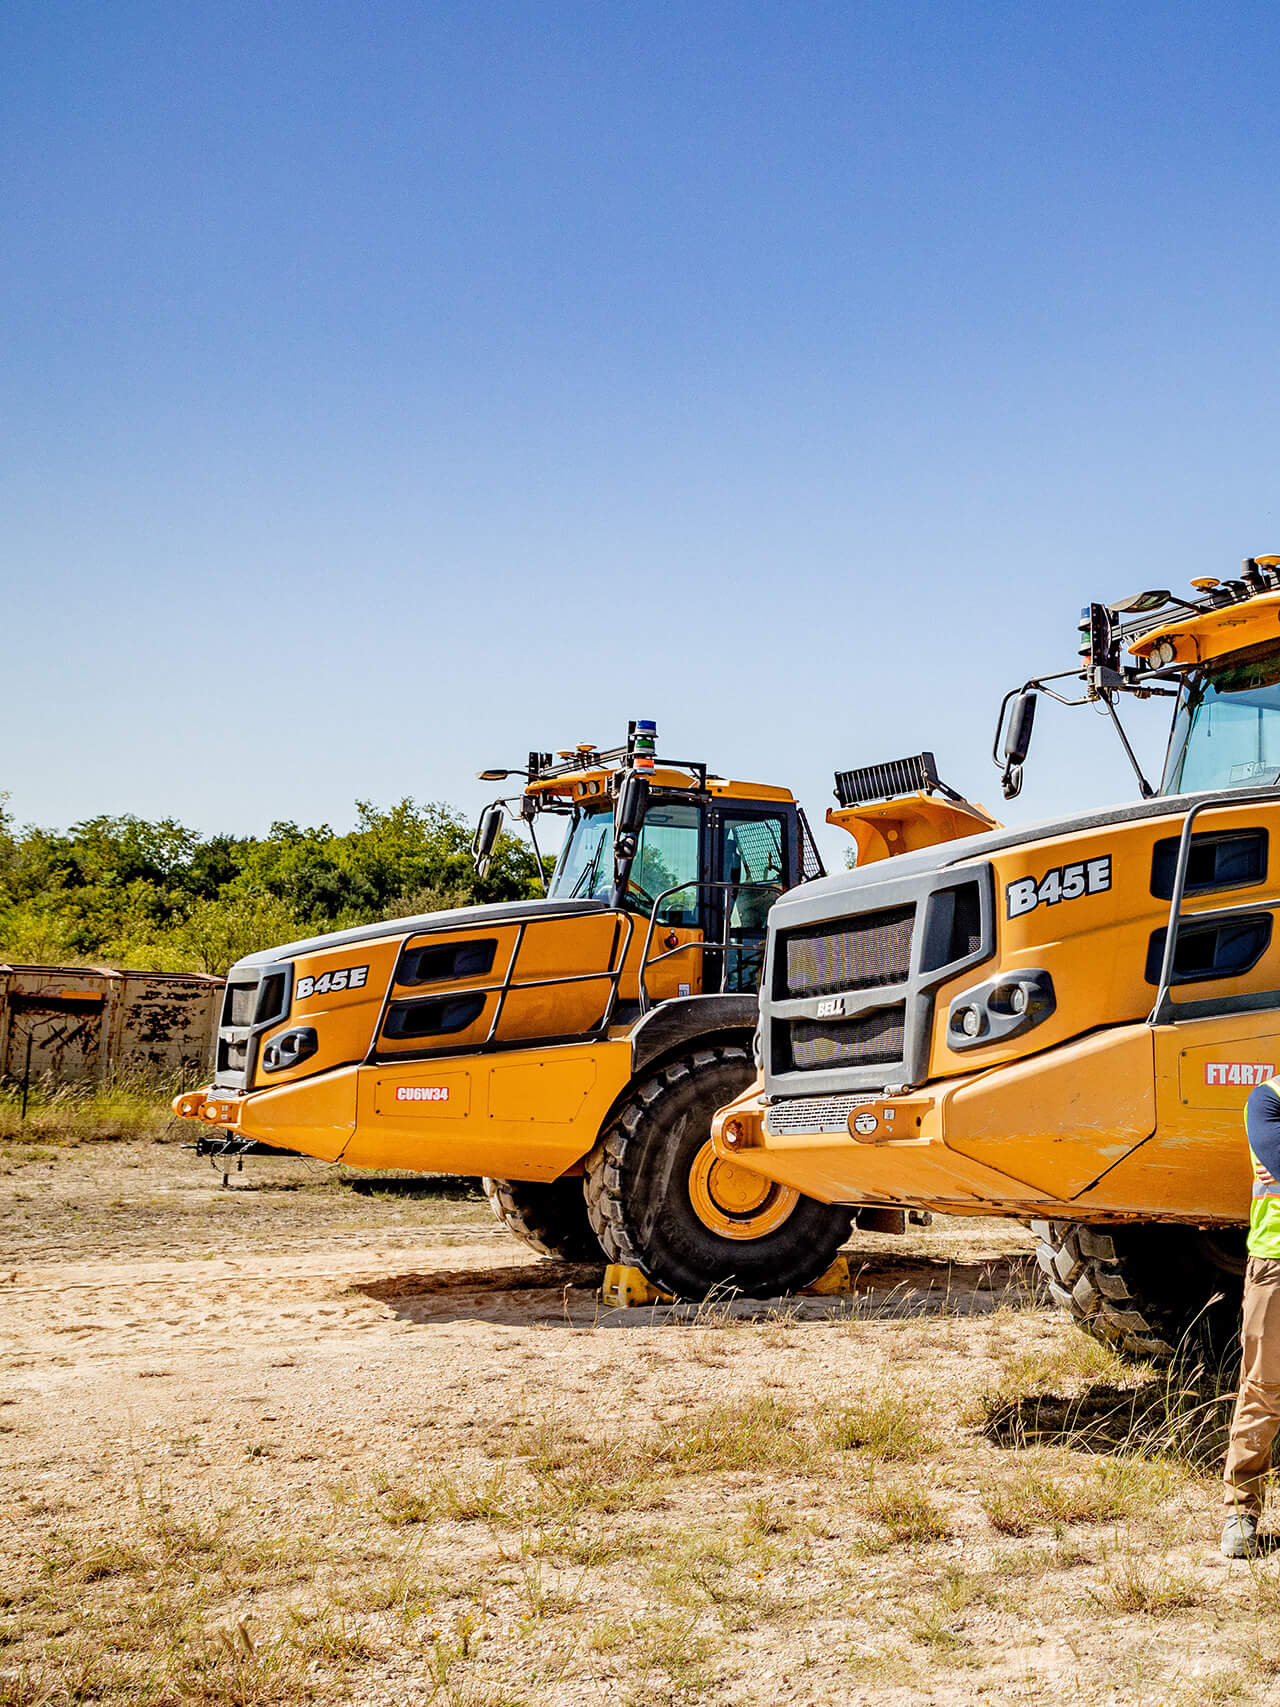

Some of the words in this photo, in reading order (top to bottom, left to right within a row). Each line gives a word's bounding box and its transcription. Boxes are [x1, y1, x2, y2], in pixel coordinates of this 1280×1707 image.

[1006, 856, 1111, 919] B45E
[296, 966, 368, 1000] B45E
[816, 999, 846, 1018] BELL
[1207, 1063, 1274, 1085] FT4R77
